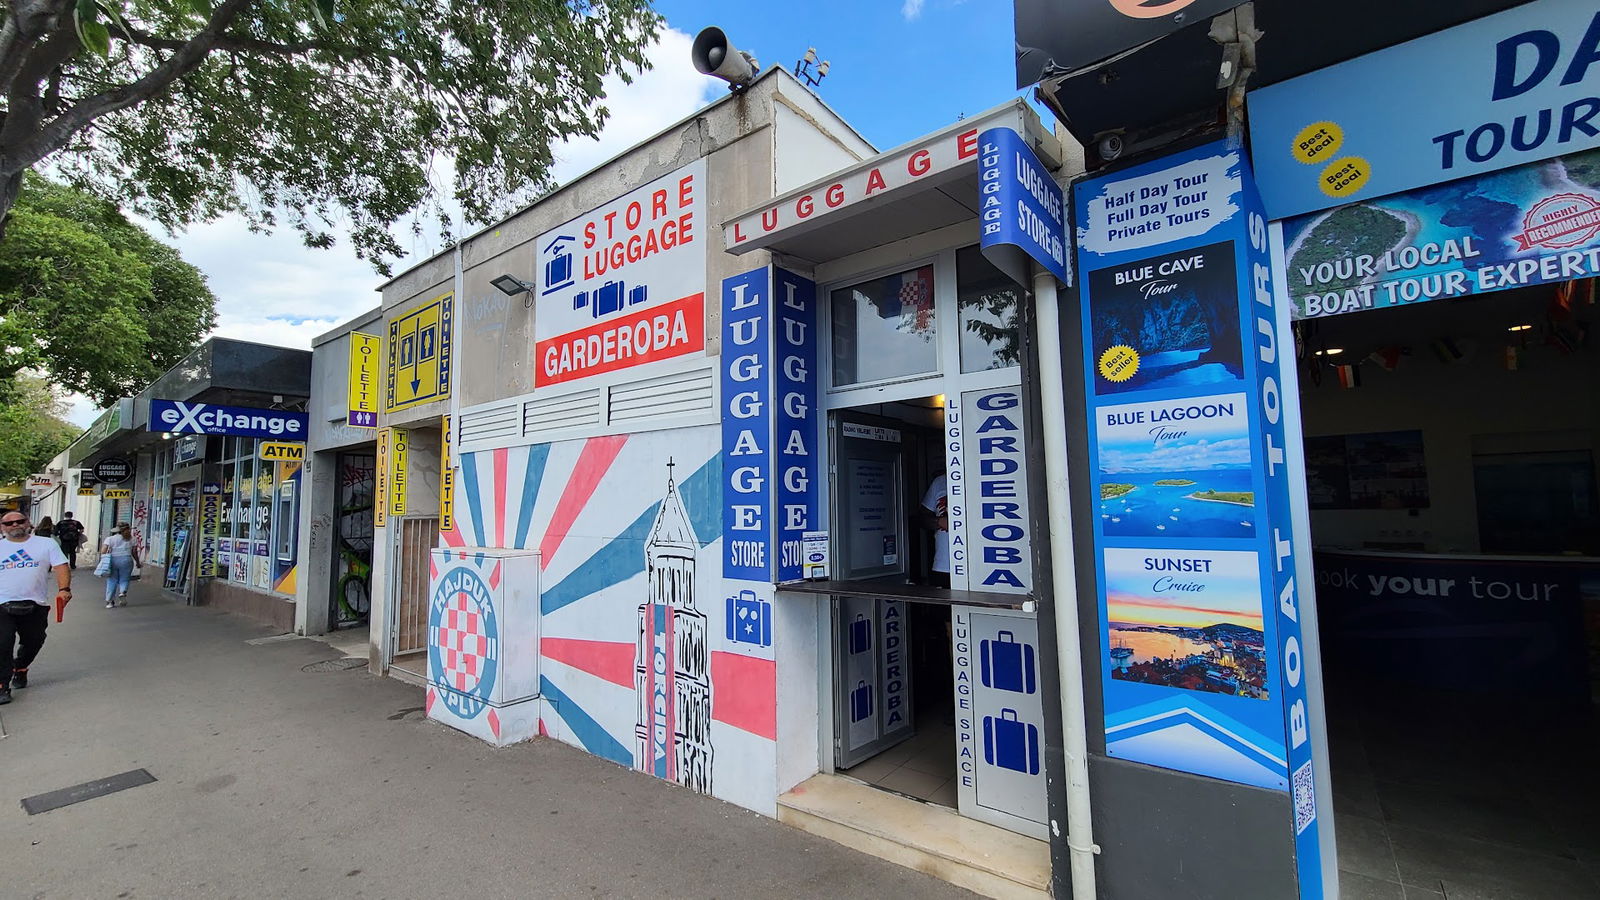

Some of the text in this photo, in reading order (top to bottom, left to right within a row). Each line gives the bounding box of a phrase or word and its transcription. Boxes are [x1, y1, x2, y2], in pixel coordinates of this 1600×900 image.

[1298, 128, 1328, 152] Best
[1306, 134, 1335, 158] deal
[734, 128, 978, 243] LUGGAGE
[981, 142, 1002, 236] LUGGAGE
[1016, 151, 1061, 226] LUGGAGE
[1105, 172, 1209, 209] Half Day Tour
[1325, 162, 1355, 185] Best
[1333, 168, 1362, 192] deal
[584, 174, 694, 249] STORE
[1018, 199, 1051, 255] STORE
[1107, 190, 1208, 225] Full Day Tour
[1108, 207, 1210, 241] Private Tours
[1542, 204, 1578, 222] HIGHLY
[583, 212, 694, 281] LUGGAGE
[1115, 254, 1204, 285] BLUE CAVE
[1300, 236, 1480, 286] YOUR LOCAL
[1140, 279, 1178, 300] Tour
[1305, 283, 1375, 317] BOAT
[1382, 270, 1467, 304] TOUR
[387, 322, 397, 408] TOILETTE
[440, 298, 452, 393] TOILETTE
[544, 309, 689, 378] GARDEROBA
[1105, 350, 1126, 369] Best
[1110, 354, 1134, 377] seller
[359, 336, 372, 410] TOILETTE
[161, 401, 301, 434] eXchange
[729, 282, 764, 531] LUGGAGE
[783, 280, 809, 531] LUGGAGE
[1107, 402, 1234, 426] BLUE LAGOON
[264, 446, 302, 458] ATM
[1149, 425, 1188, 444] Tour
[378, 434, 387, 522] TOILETTE
[395, 432, 406, 512] TOILETTE
[443, 417, 453, 527] TOILETTE
[949, 399, 964, 576] LUGGAGE SPACE
[975, 392, 1025, 588] GARDEROBA
[1249, 211, 1307, 749] BOAT TOURS
[201, 496, 218, 576] BAGGAGE STORAGE
[731, 540, 765, 569] STORE
[782, 540, 803, 568] STO
[1144, 557, 1212, 573] SUNSET
[1152, 576, 1205, 593] Cruise
[1368, 574, 1455, 597] your
[1468, 575, 1560, 602] tour
[435, 568, 493, 617] HAJDUK
[438, 675, 484, 715] SPLIT
[653, 631, 666, 761] TORCIDA
[956, 614, 972, 788] LUGGAGE SPACE
